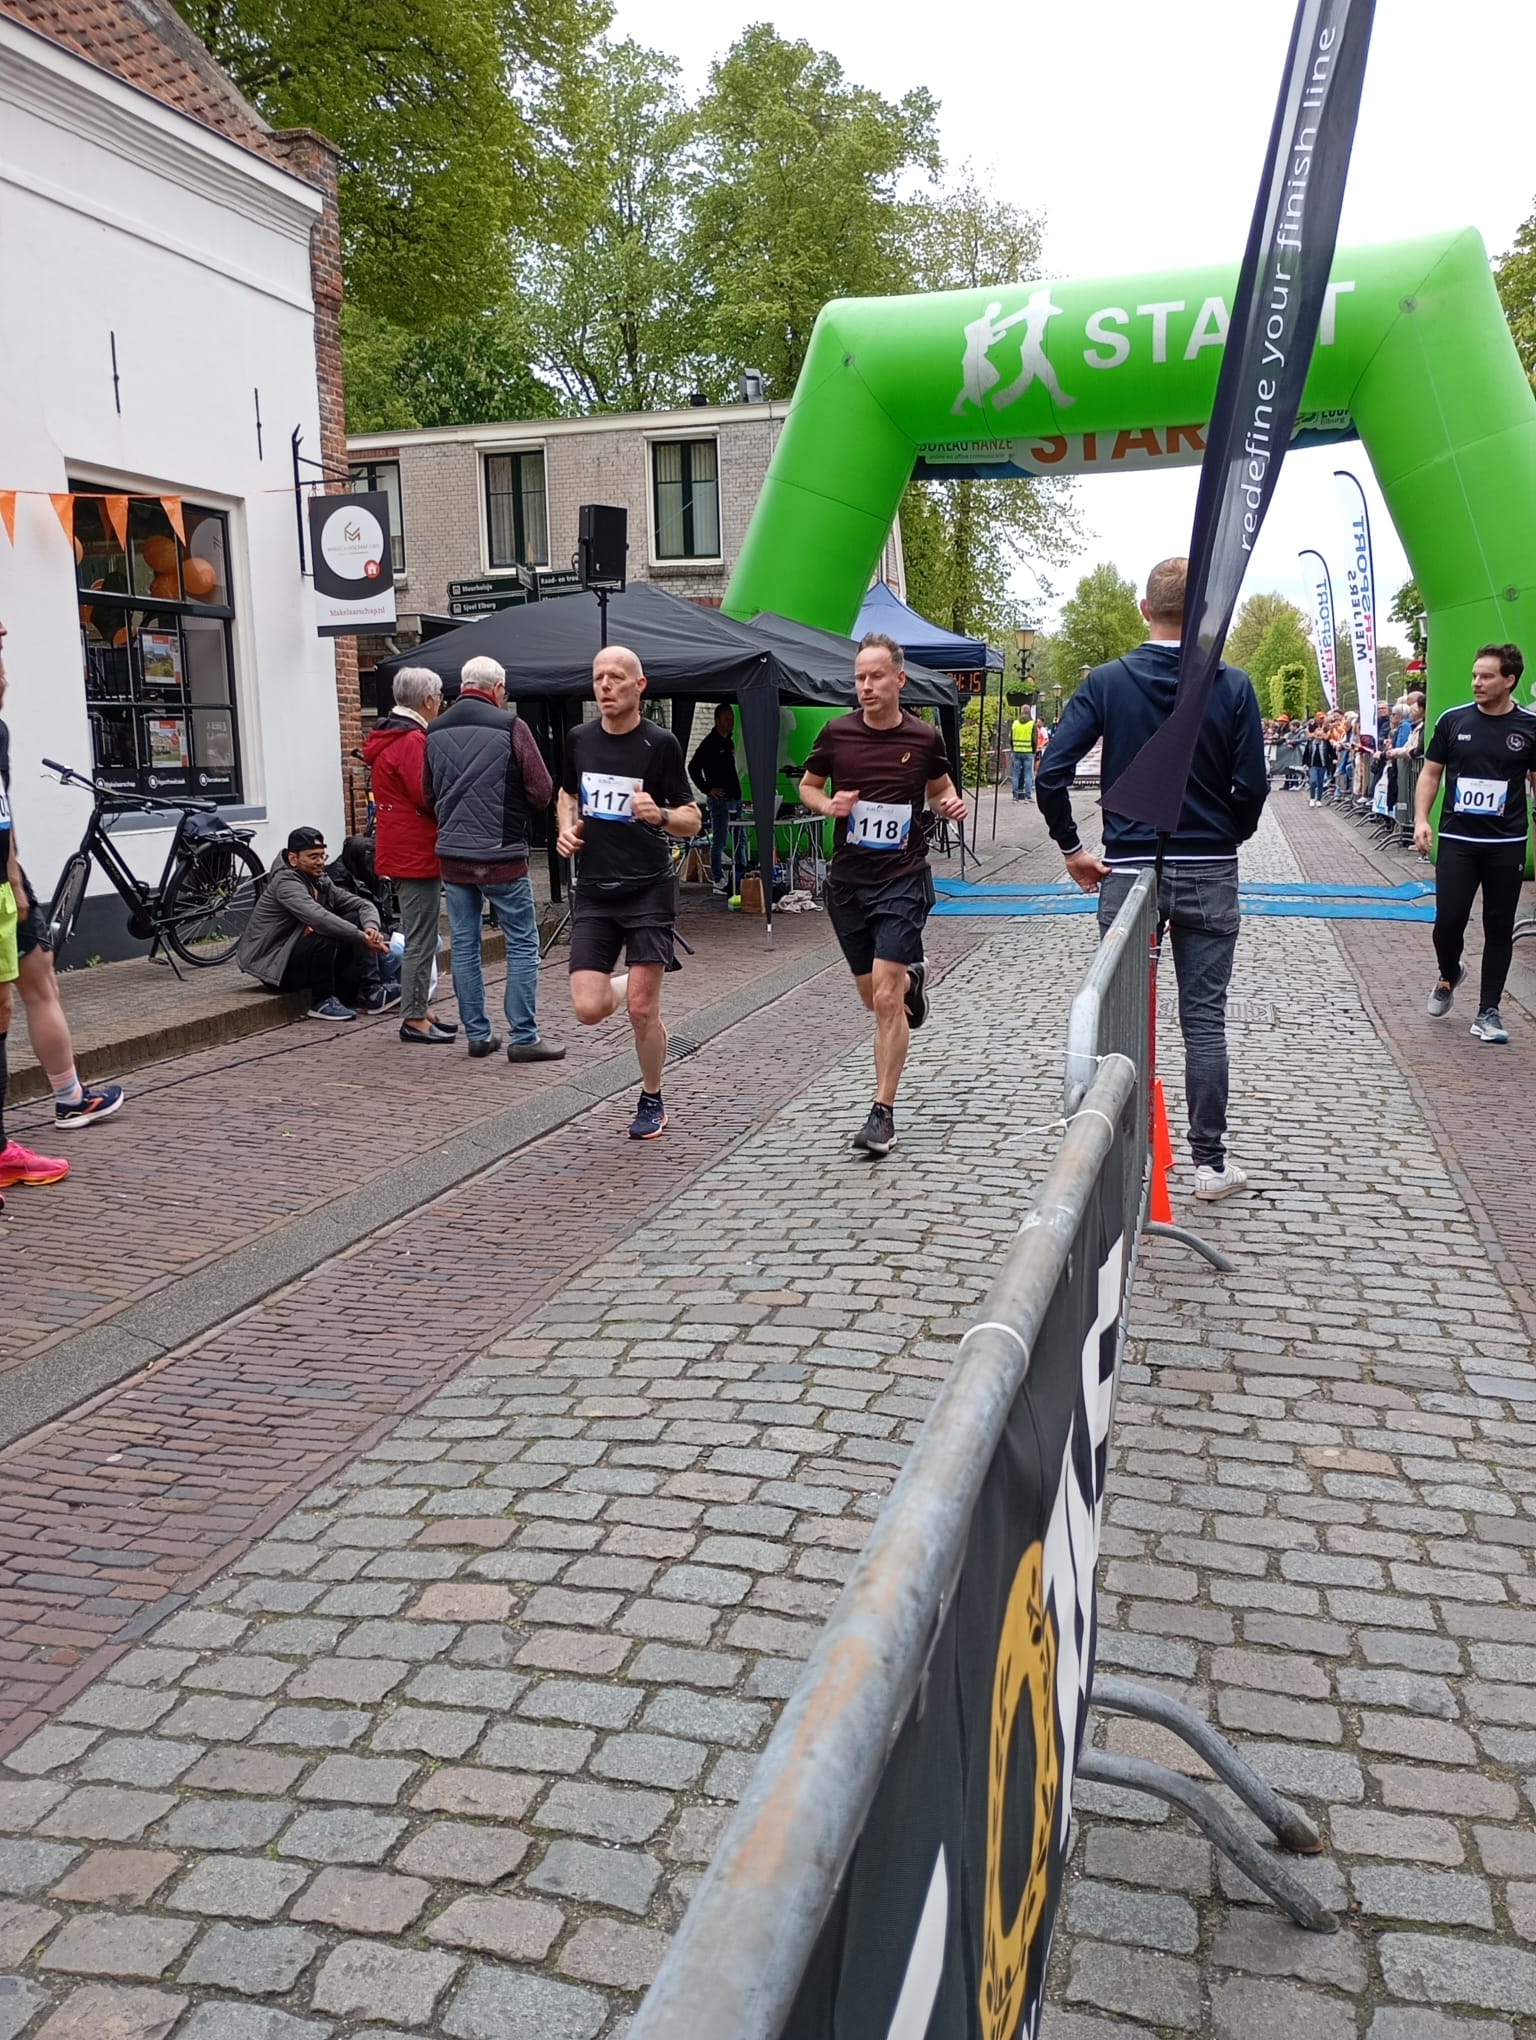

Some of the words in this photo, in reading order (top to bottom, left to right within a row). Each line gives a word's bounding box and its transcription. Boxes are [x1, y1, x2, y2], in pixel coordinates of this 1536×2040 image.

[1303, 26, 1336, 108] line
[1276, 127, 1316, 253] finish
[1083, 280, 1356, 369] STAT
[1262, 263, 1291, 367] your
[1241, 379, 1276, 551] redefine
[329, 606, 385, 617] Makelaarschap.nl
[478, 602, 497, 610] Elburg
[591, 789, 630, 812] 117
[1463, 791, 1495, 808] 001
[859, 817, 898, 840] 118
